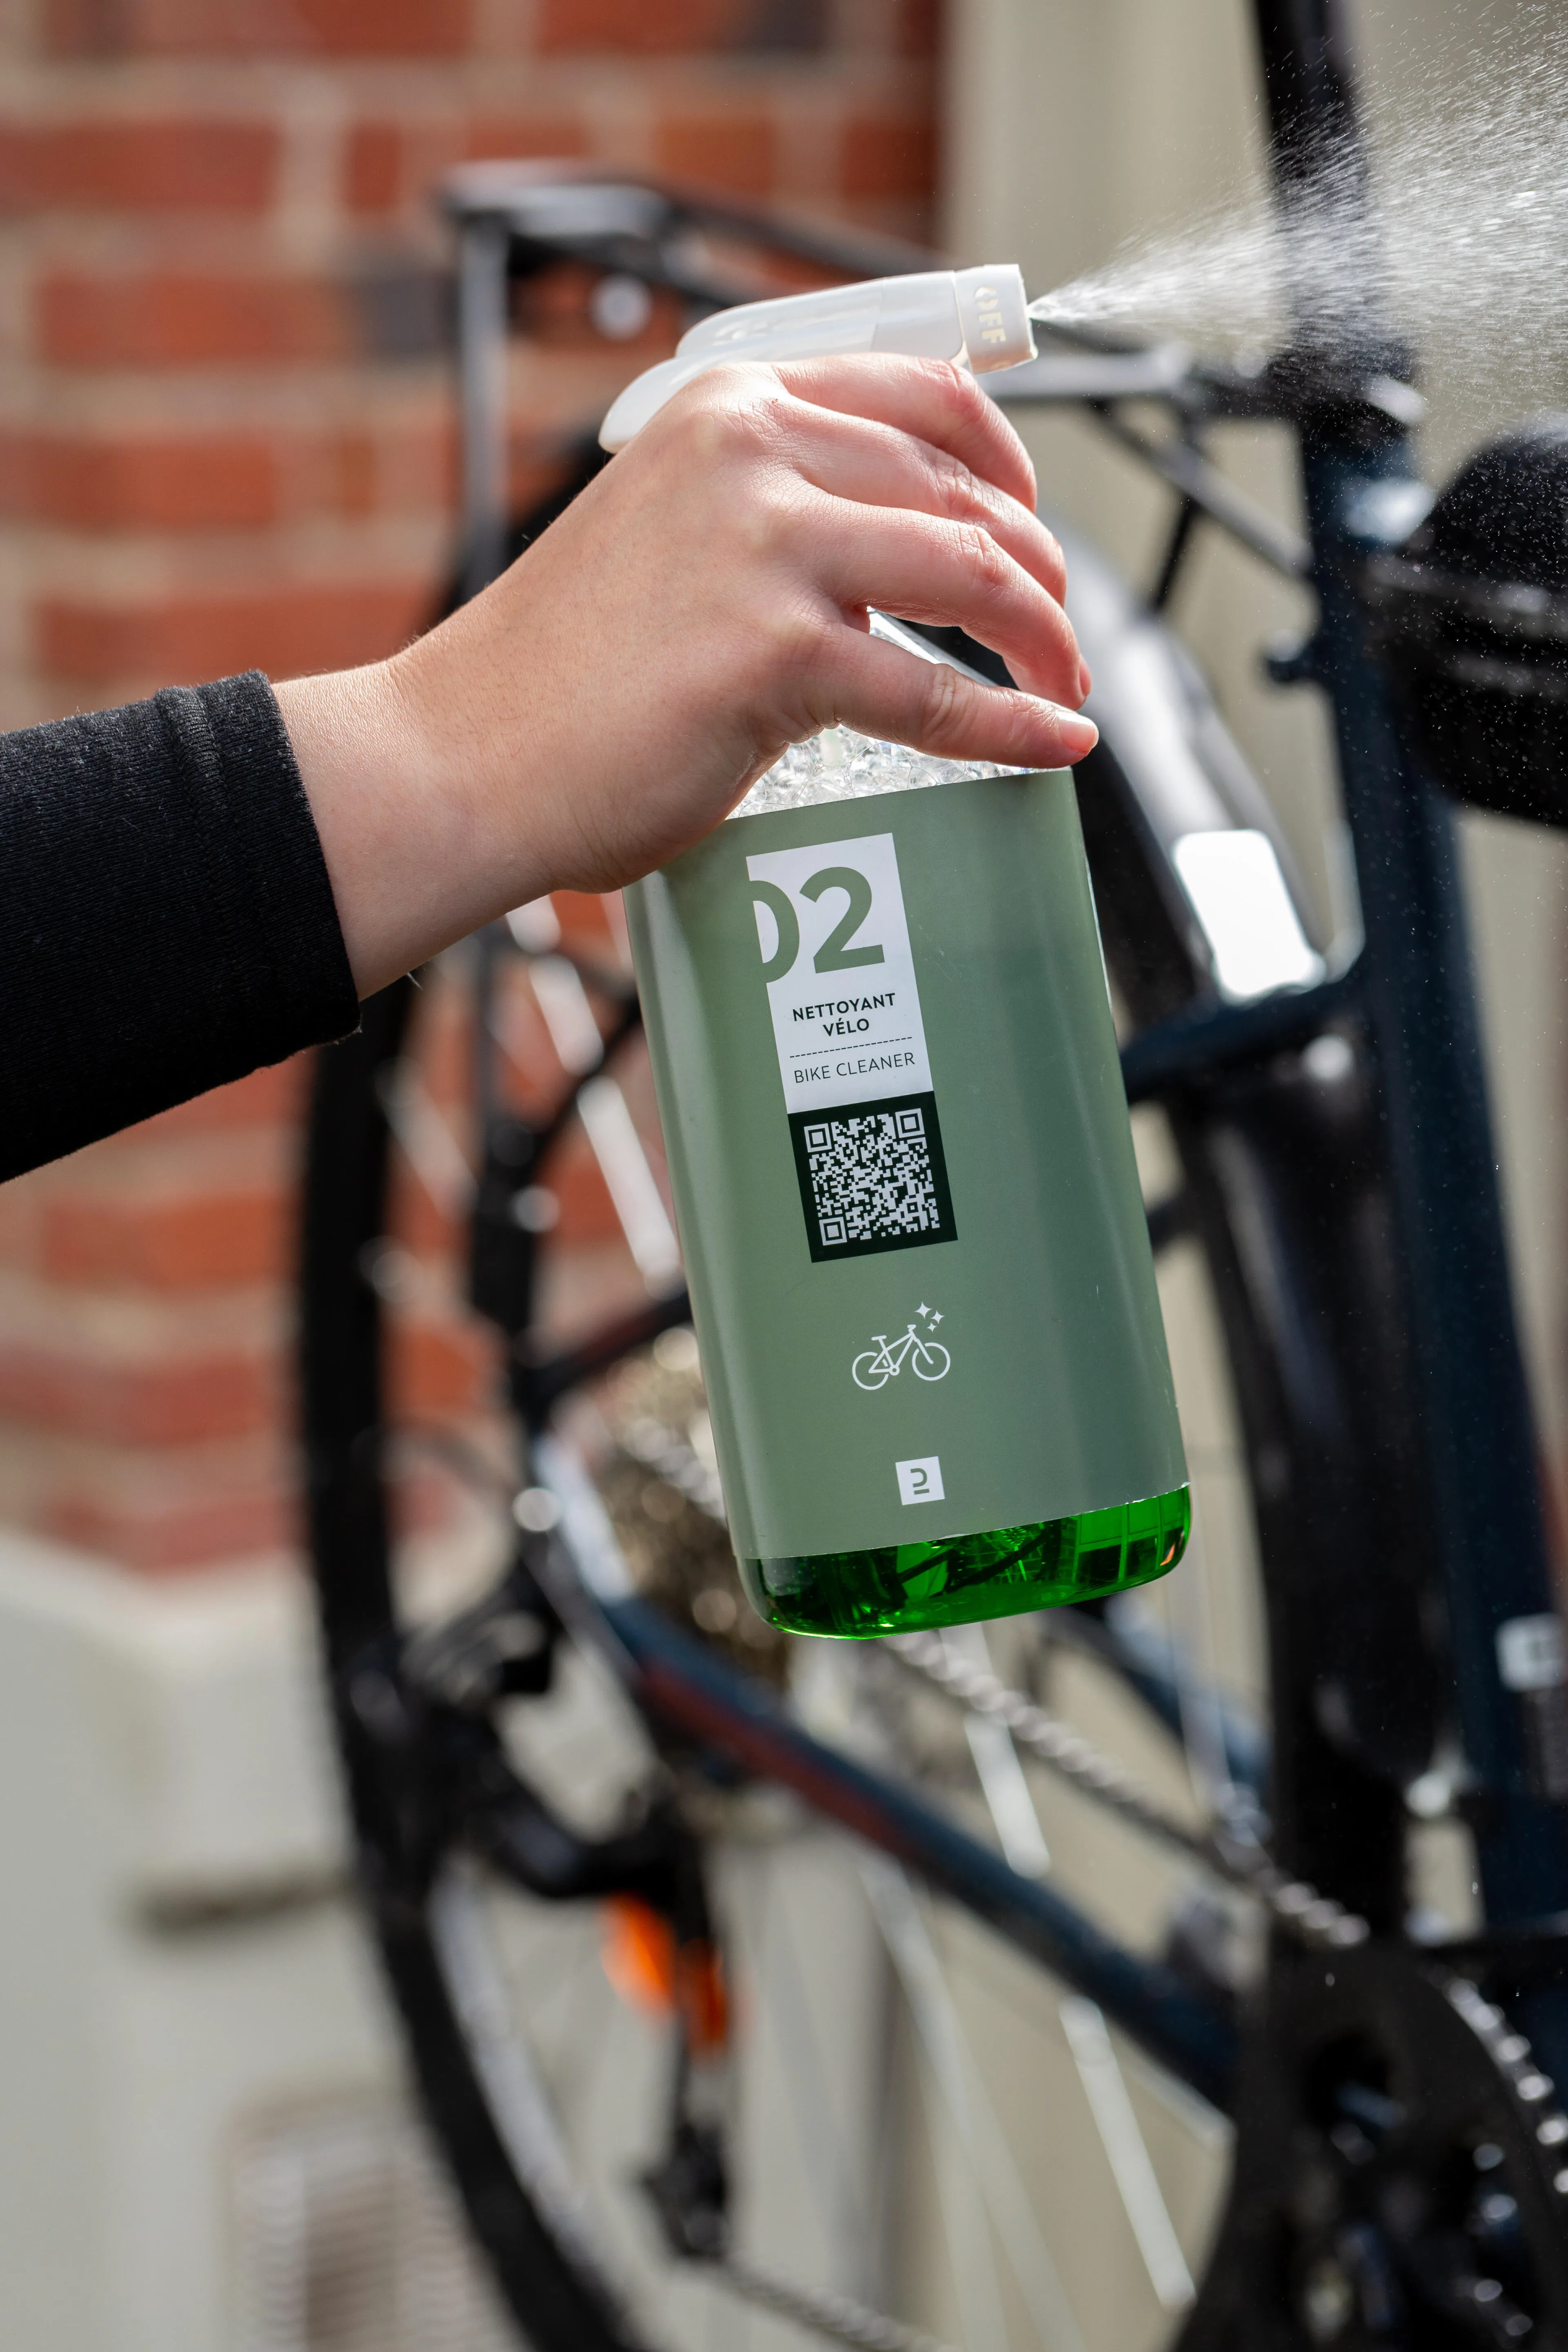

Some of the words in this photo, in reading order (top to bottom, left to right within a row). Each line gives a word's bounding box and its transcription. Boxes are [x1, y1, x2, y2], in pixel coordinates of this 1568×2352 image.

[975, 287, 1006, 344] OFF
[793, 992, 895, 1022] NETTOYANT
[822, 1018, 870, 1036] VÉLO
[794, 1065, 831, 1083] BIKE
[836, 1052, 915, 1076] CLEANER
